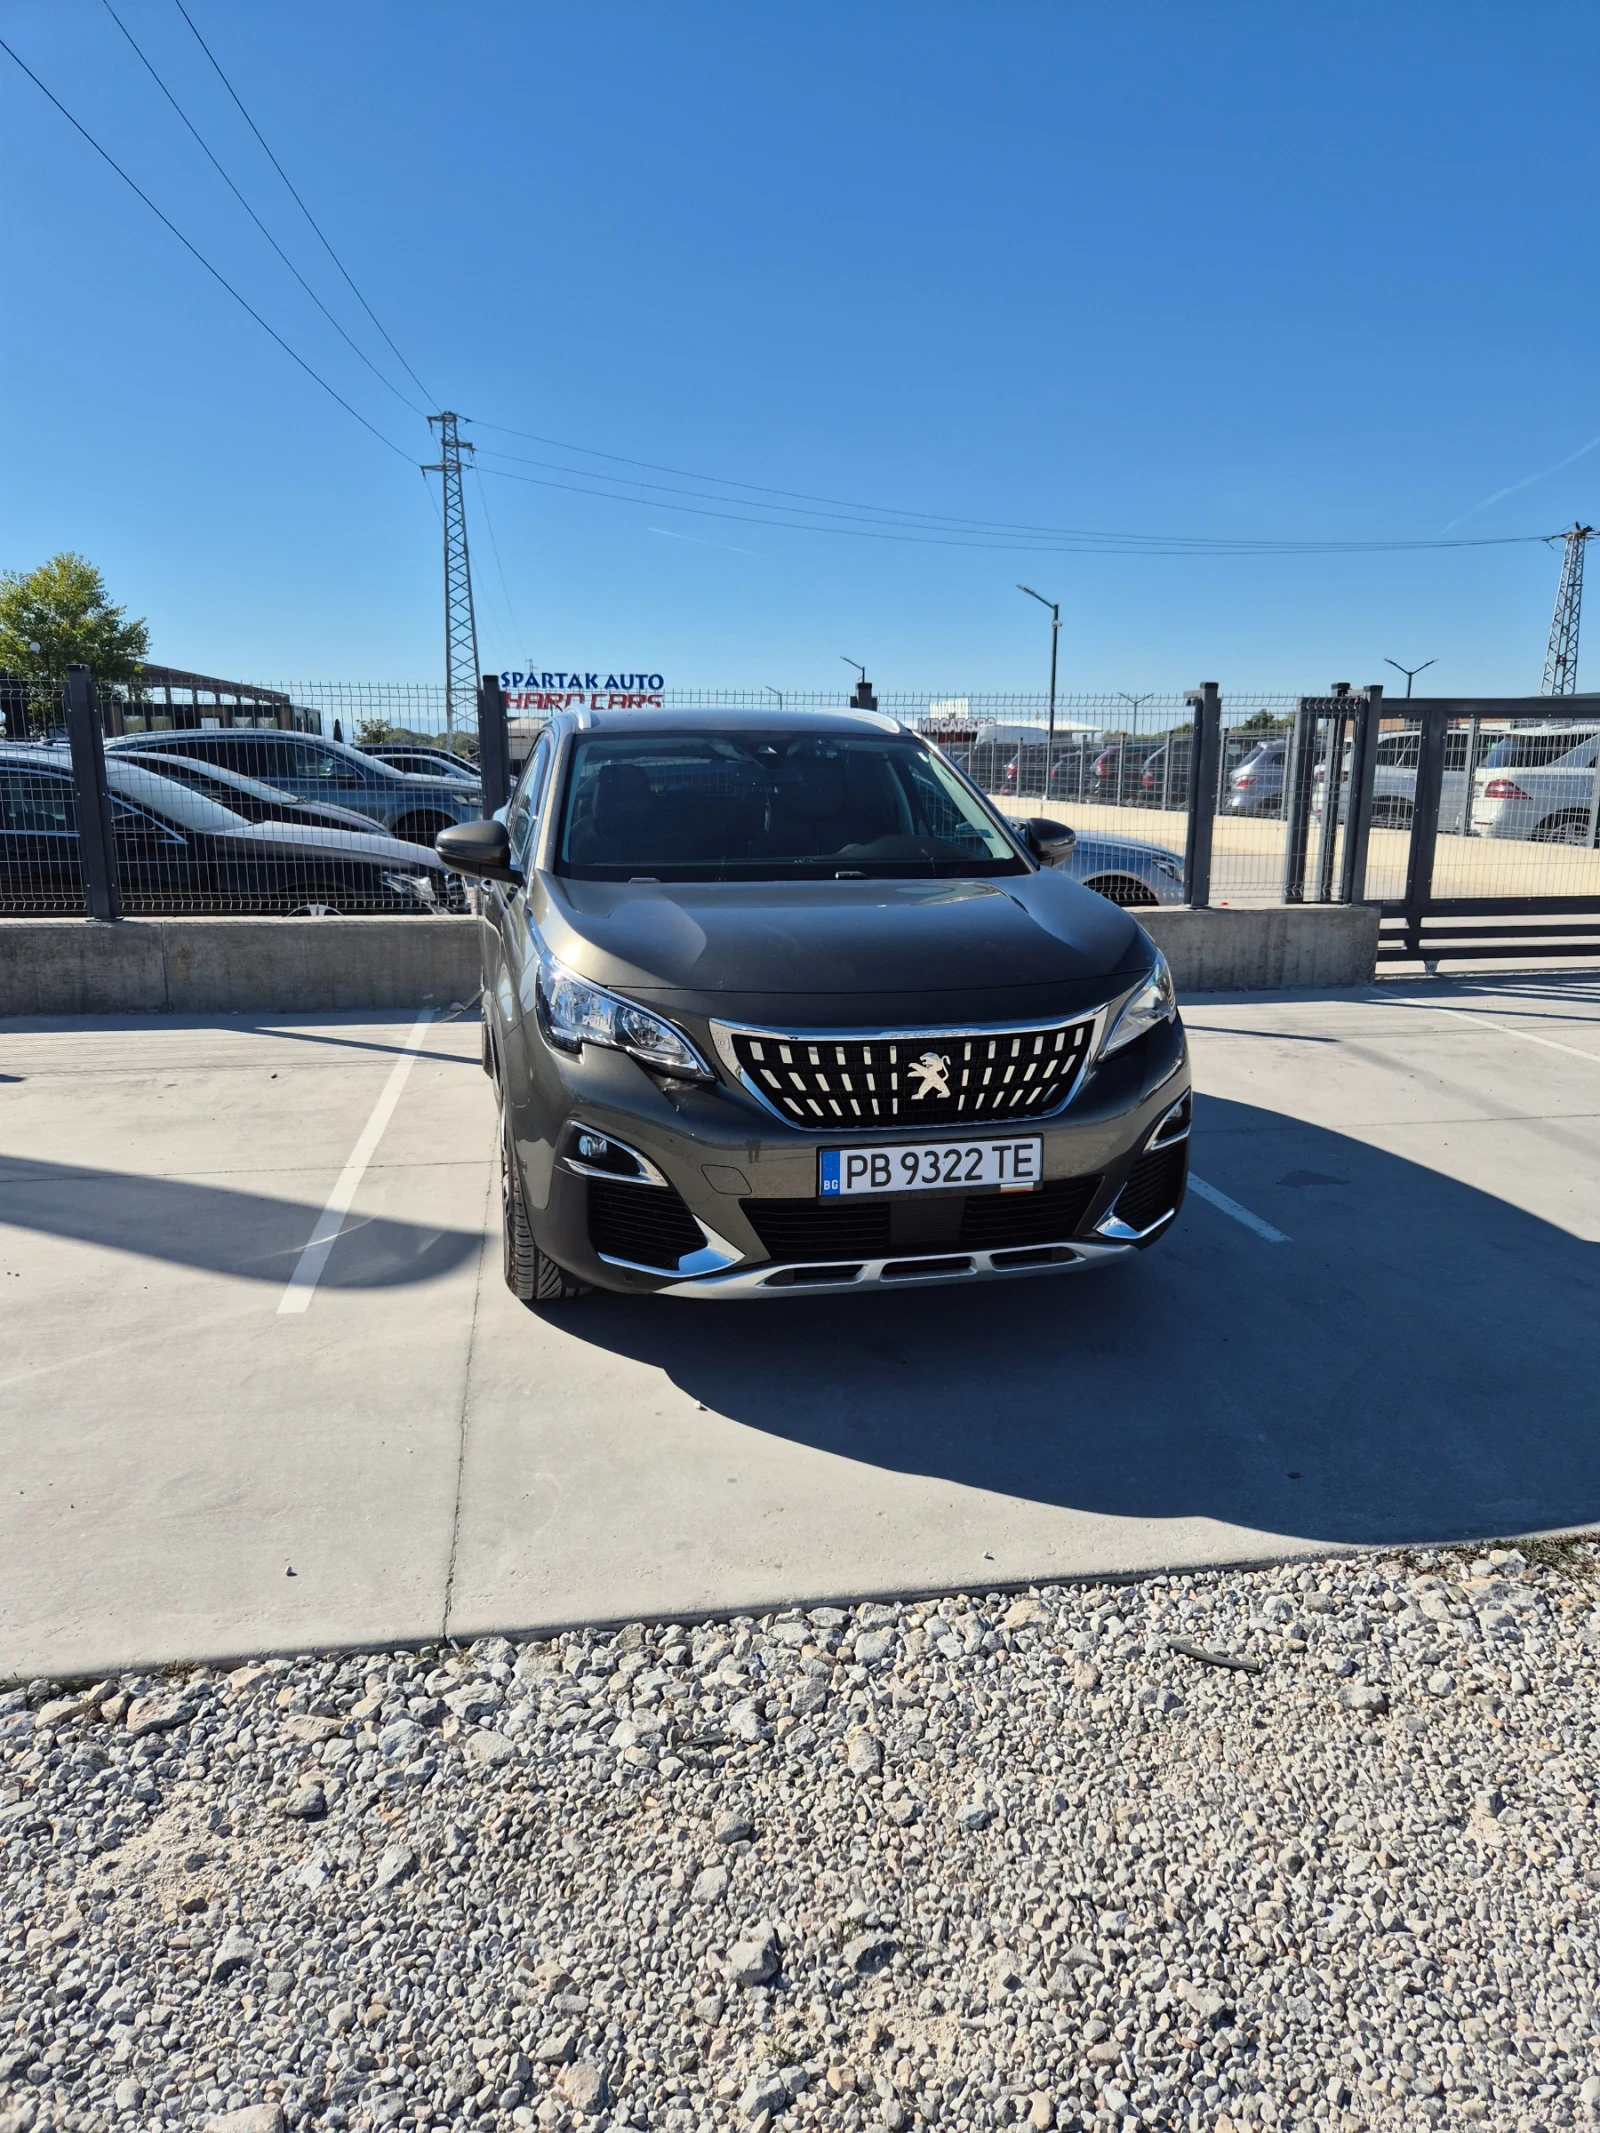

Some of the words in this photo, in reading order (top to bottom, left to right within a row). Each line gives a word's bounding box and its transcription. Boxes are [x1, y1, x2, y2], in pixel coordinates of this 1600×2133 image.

[501, 671, 599, 690] SPARTAK
[604, 673, 665, 690] AUTO
[590, 693, 664, 711] CARS
[846, 1153, 892, 1189] PB
[900, 1147, 983, 1186] 9322
[991, 1143, 1034, 1179] TE
[823, 1180, 839, 1191] BG
